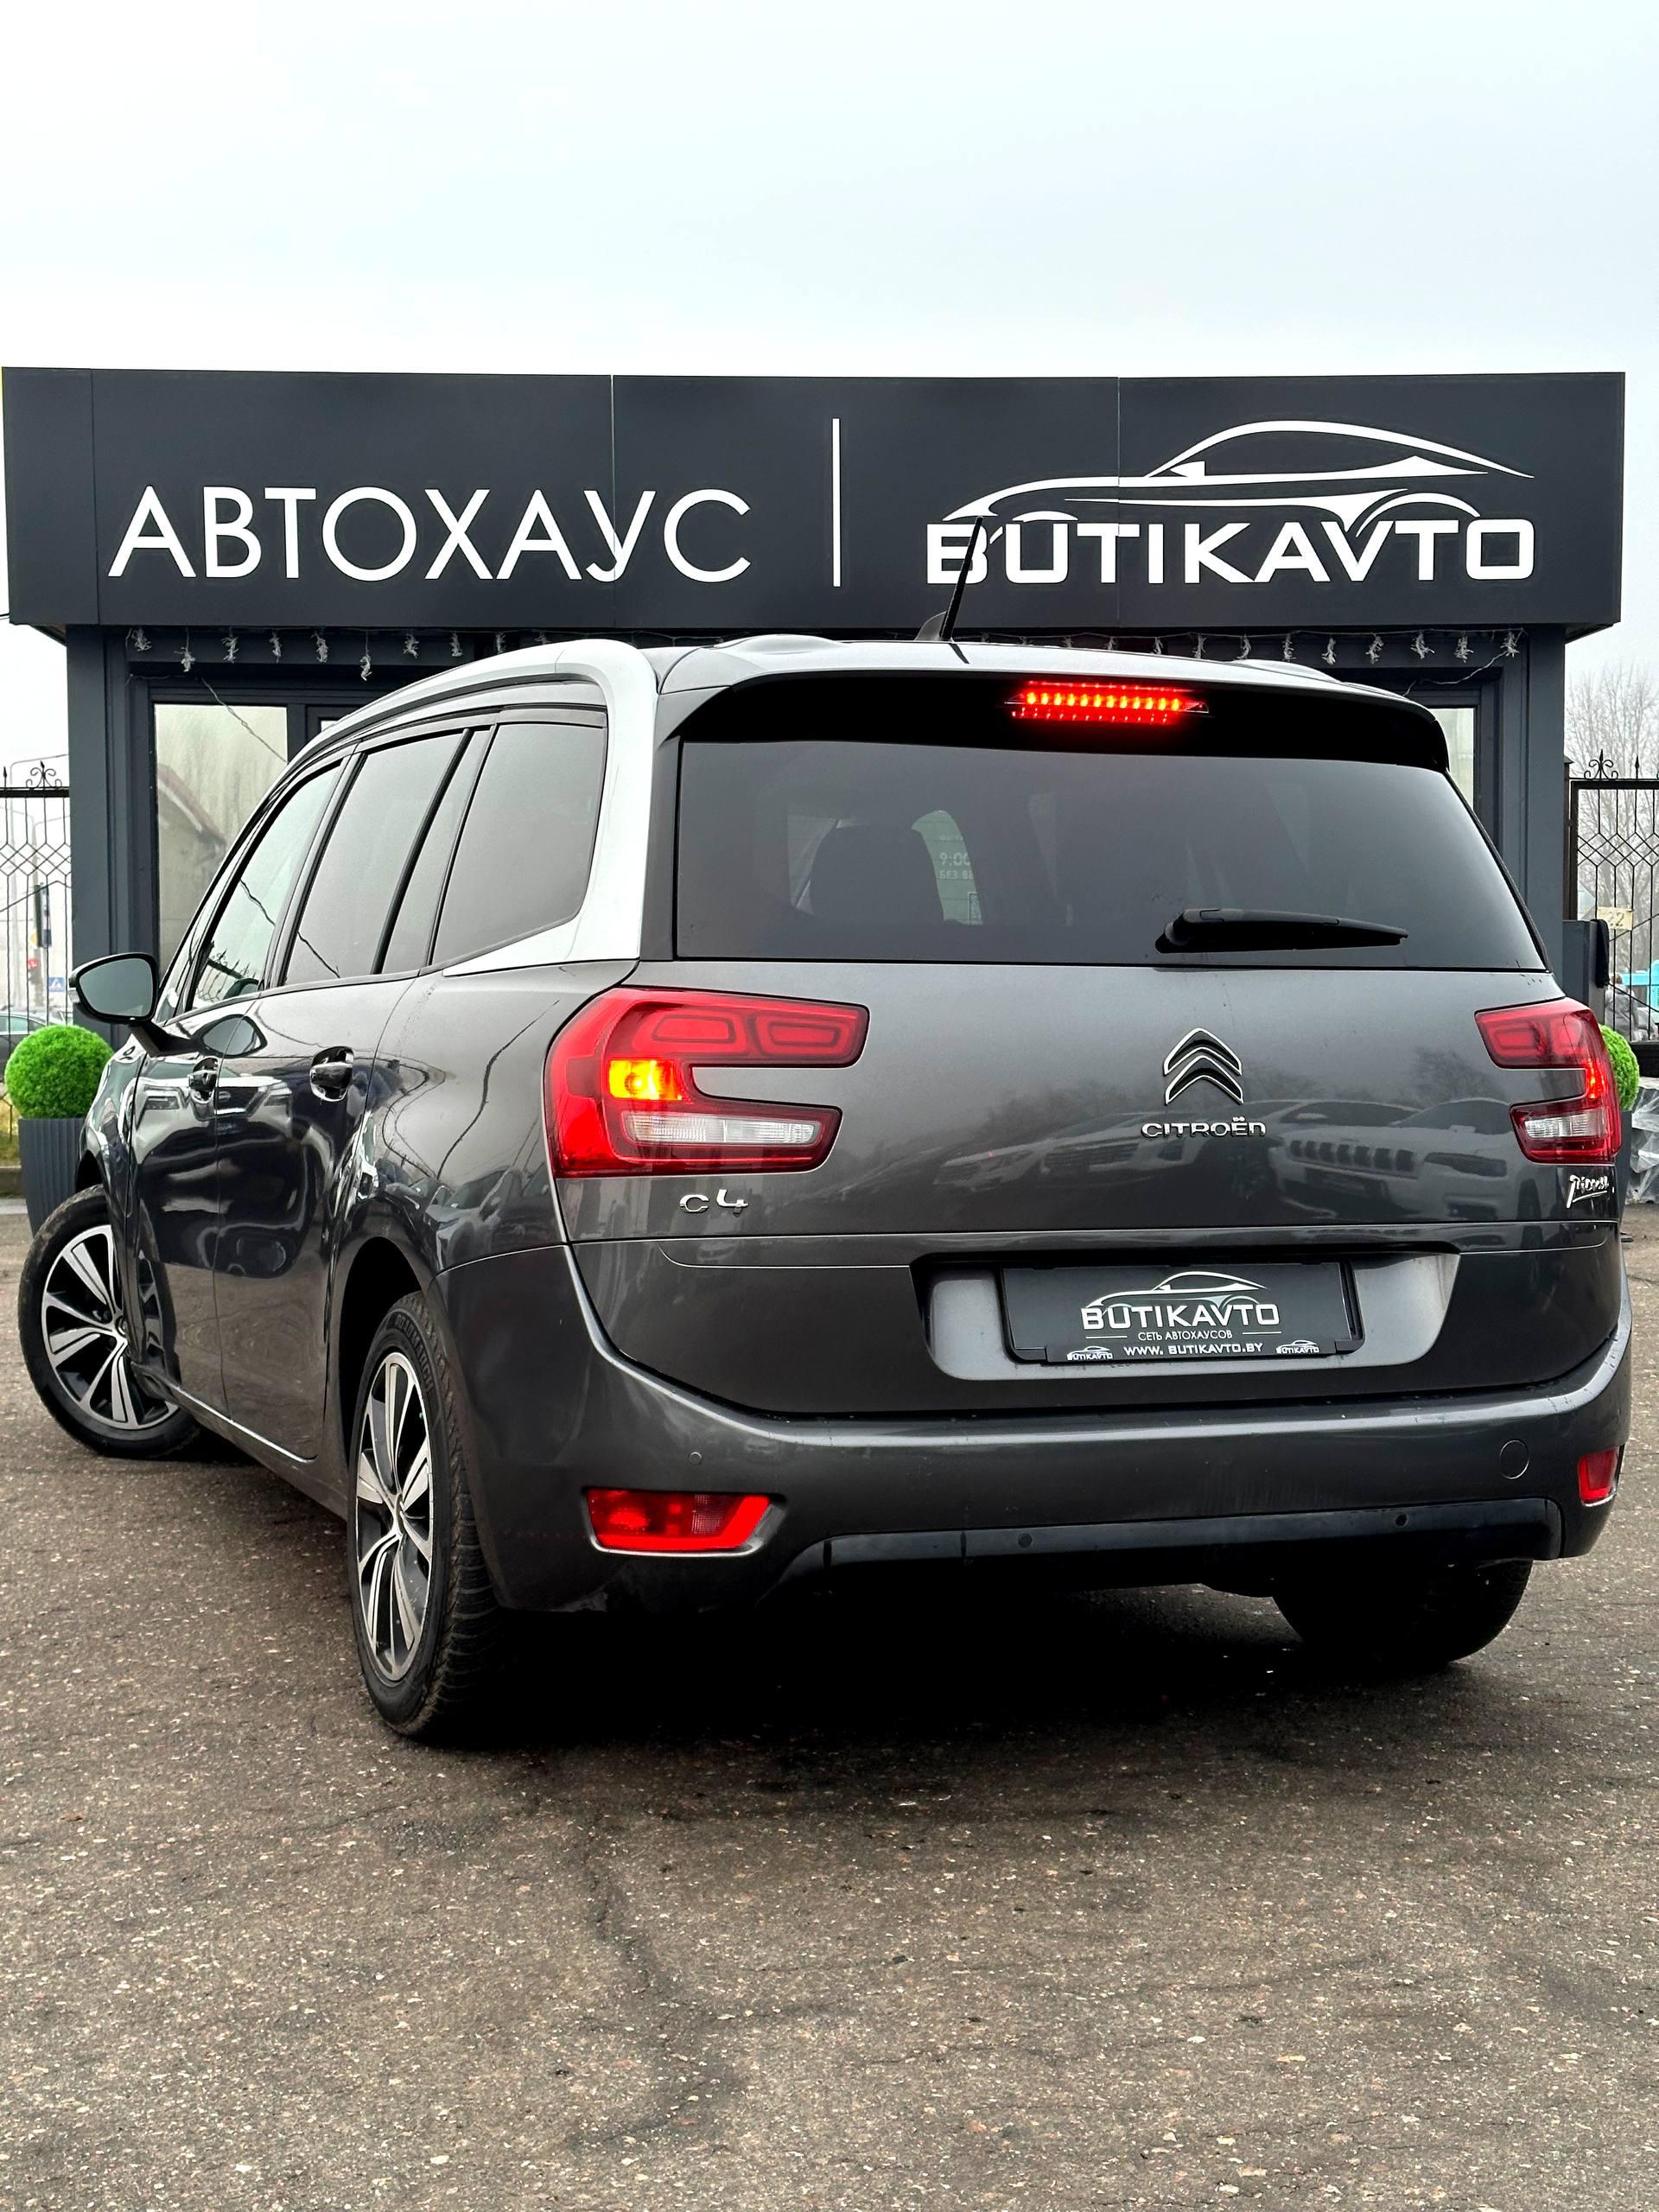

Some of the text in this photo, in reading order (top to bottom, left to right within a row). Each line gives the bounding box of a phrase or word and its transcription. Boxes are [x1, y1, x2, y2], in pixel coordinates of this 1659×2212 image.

[108, 485, 752, 583] АВТОХАУС
[926, 518, 1535, 585] BUTIKAVTO
[1081, 1304, 1280, 1330] BUTIKAVTO
[1138, 1330, 1233, 1341] СЕТЬ АВТОХАУСОВ
